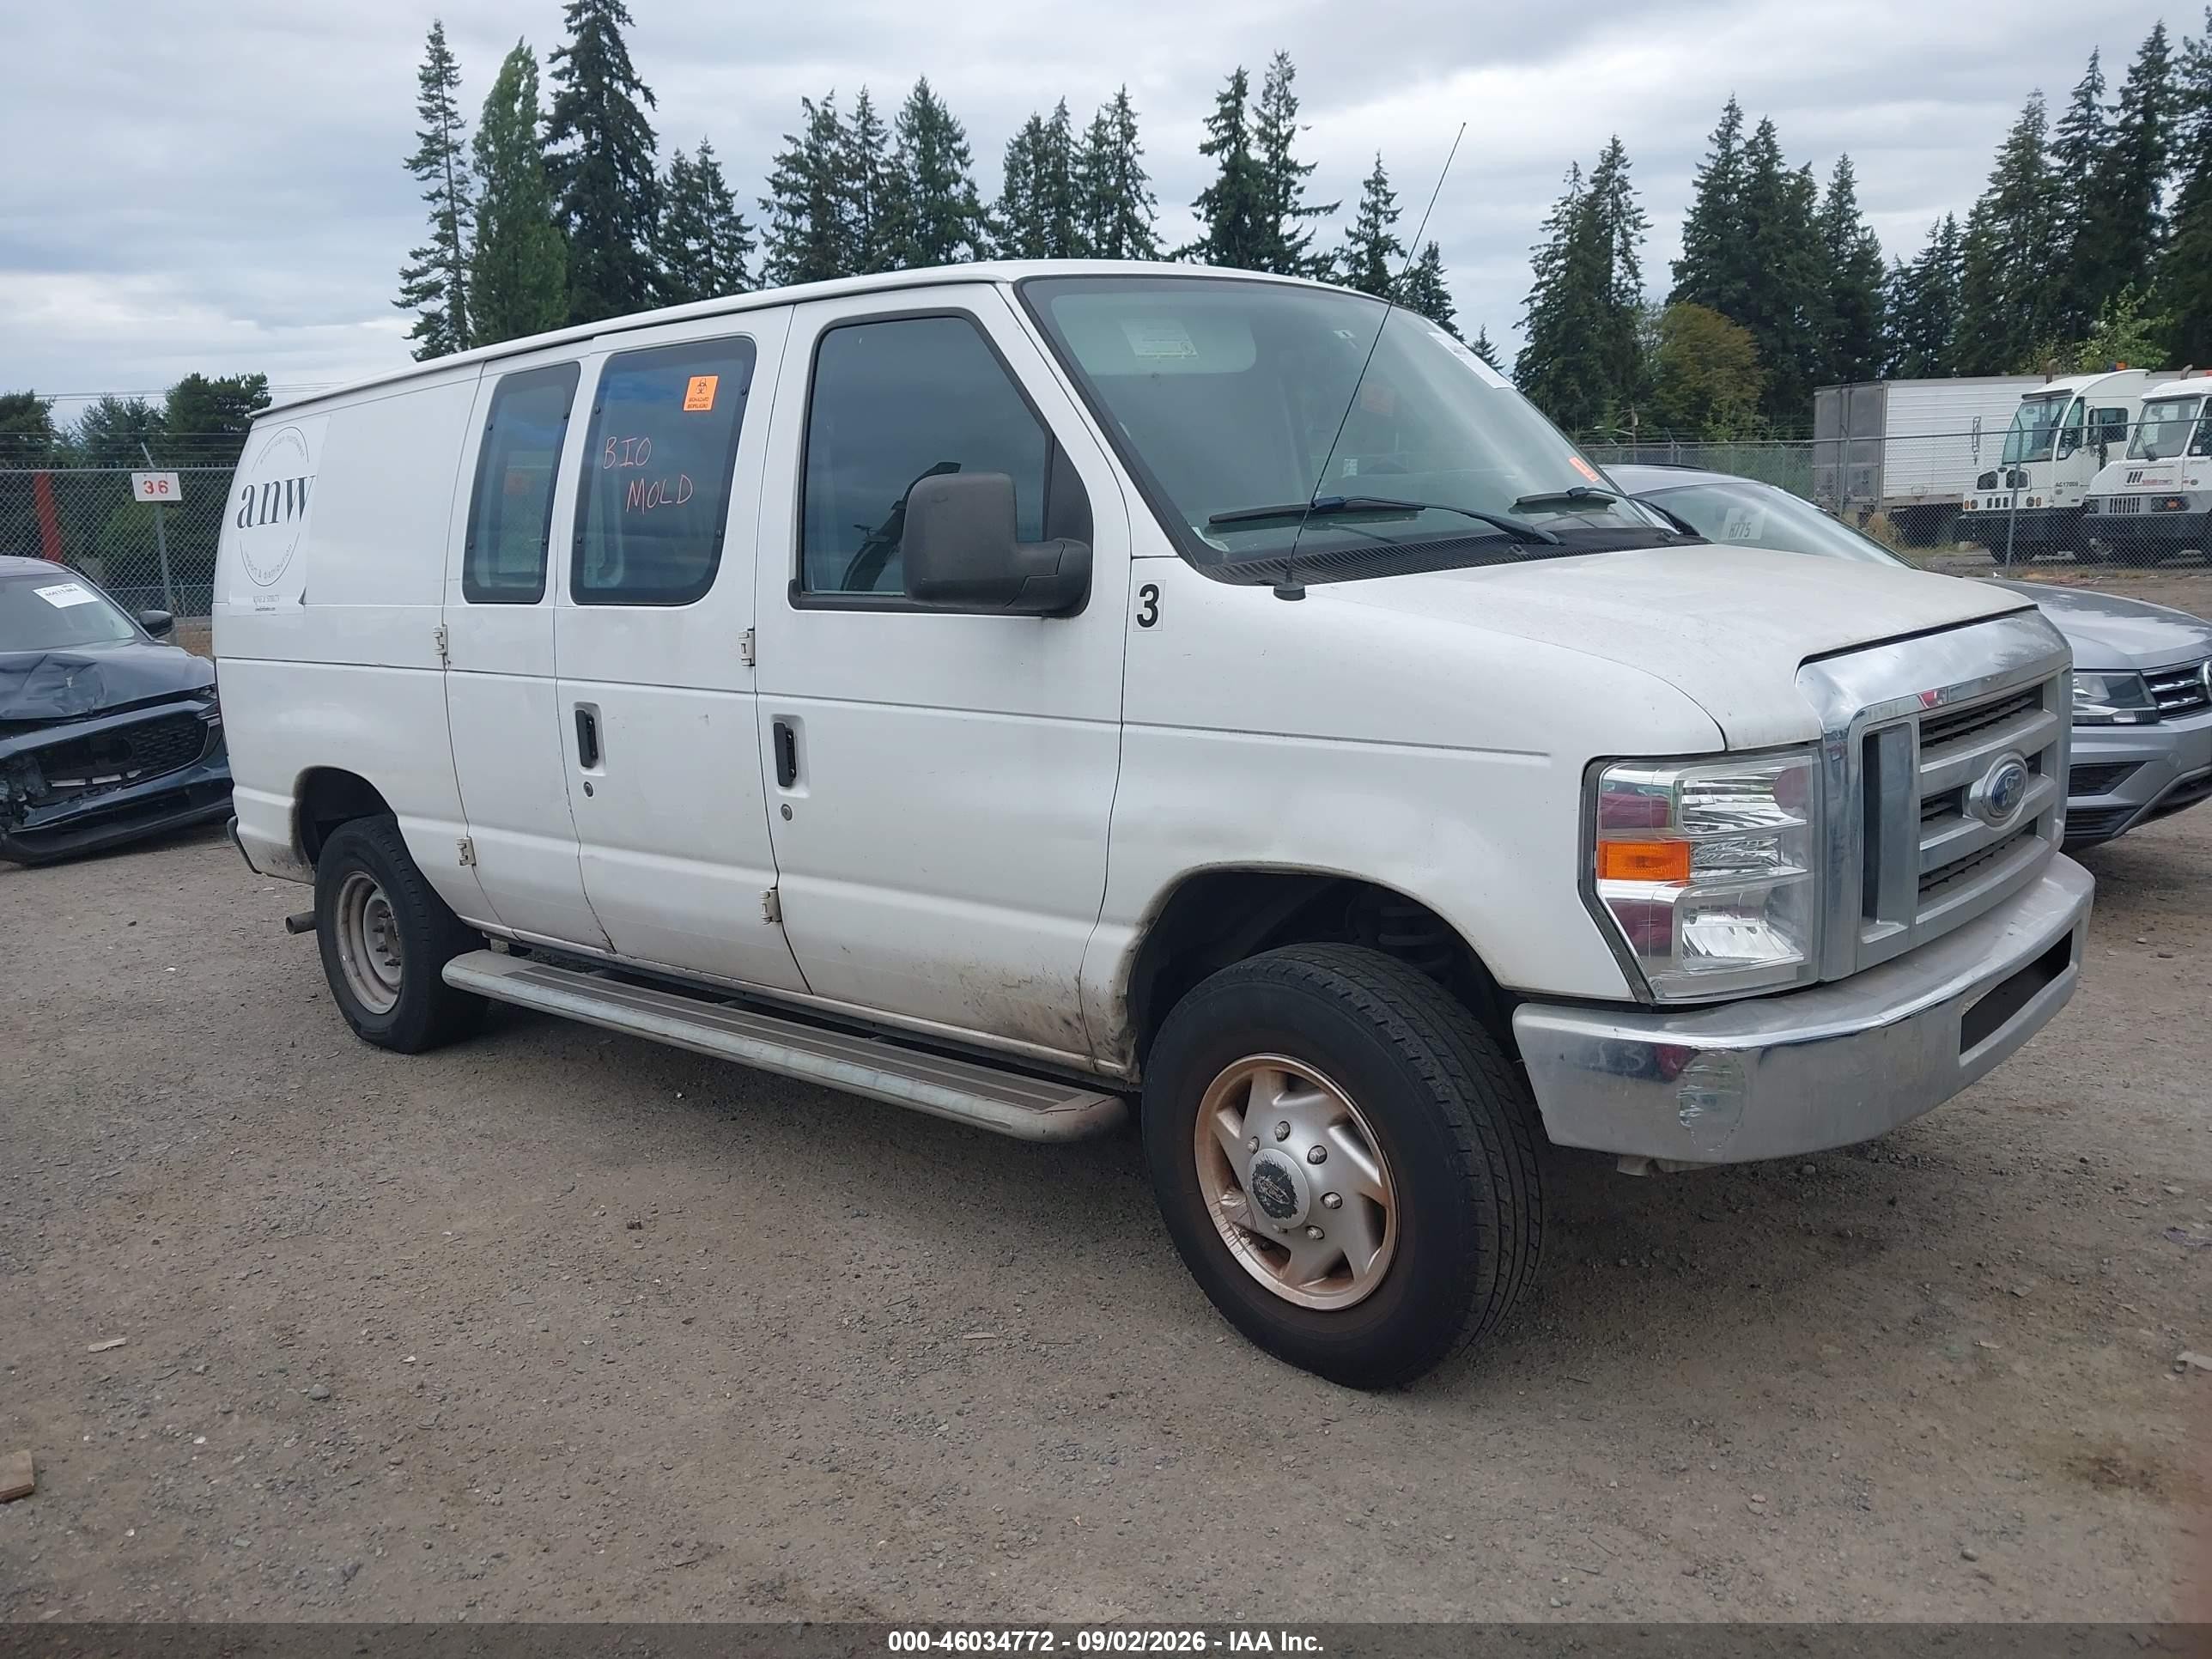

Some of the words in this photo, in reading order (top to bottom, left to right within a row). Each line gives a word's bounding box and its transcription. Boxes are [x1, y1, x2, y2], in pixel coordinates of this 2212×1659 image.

[603, 436, 652, 469] BIO
[143, 480, 168, 495] 36
[236, 475, 316, 529] anw
[626, 474, 694, 515] MOLD
[1136, 583, 1159, 628] 3
